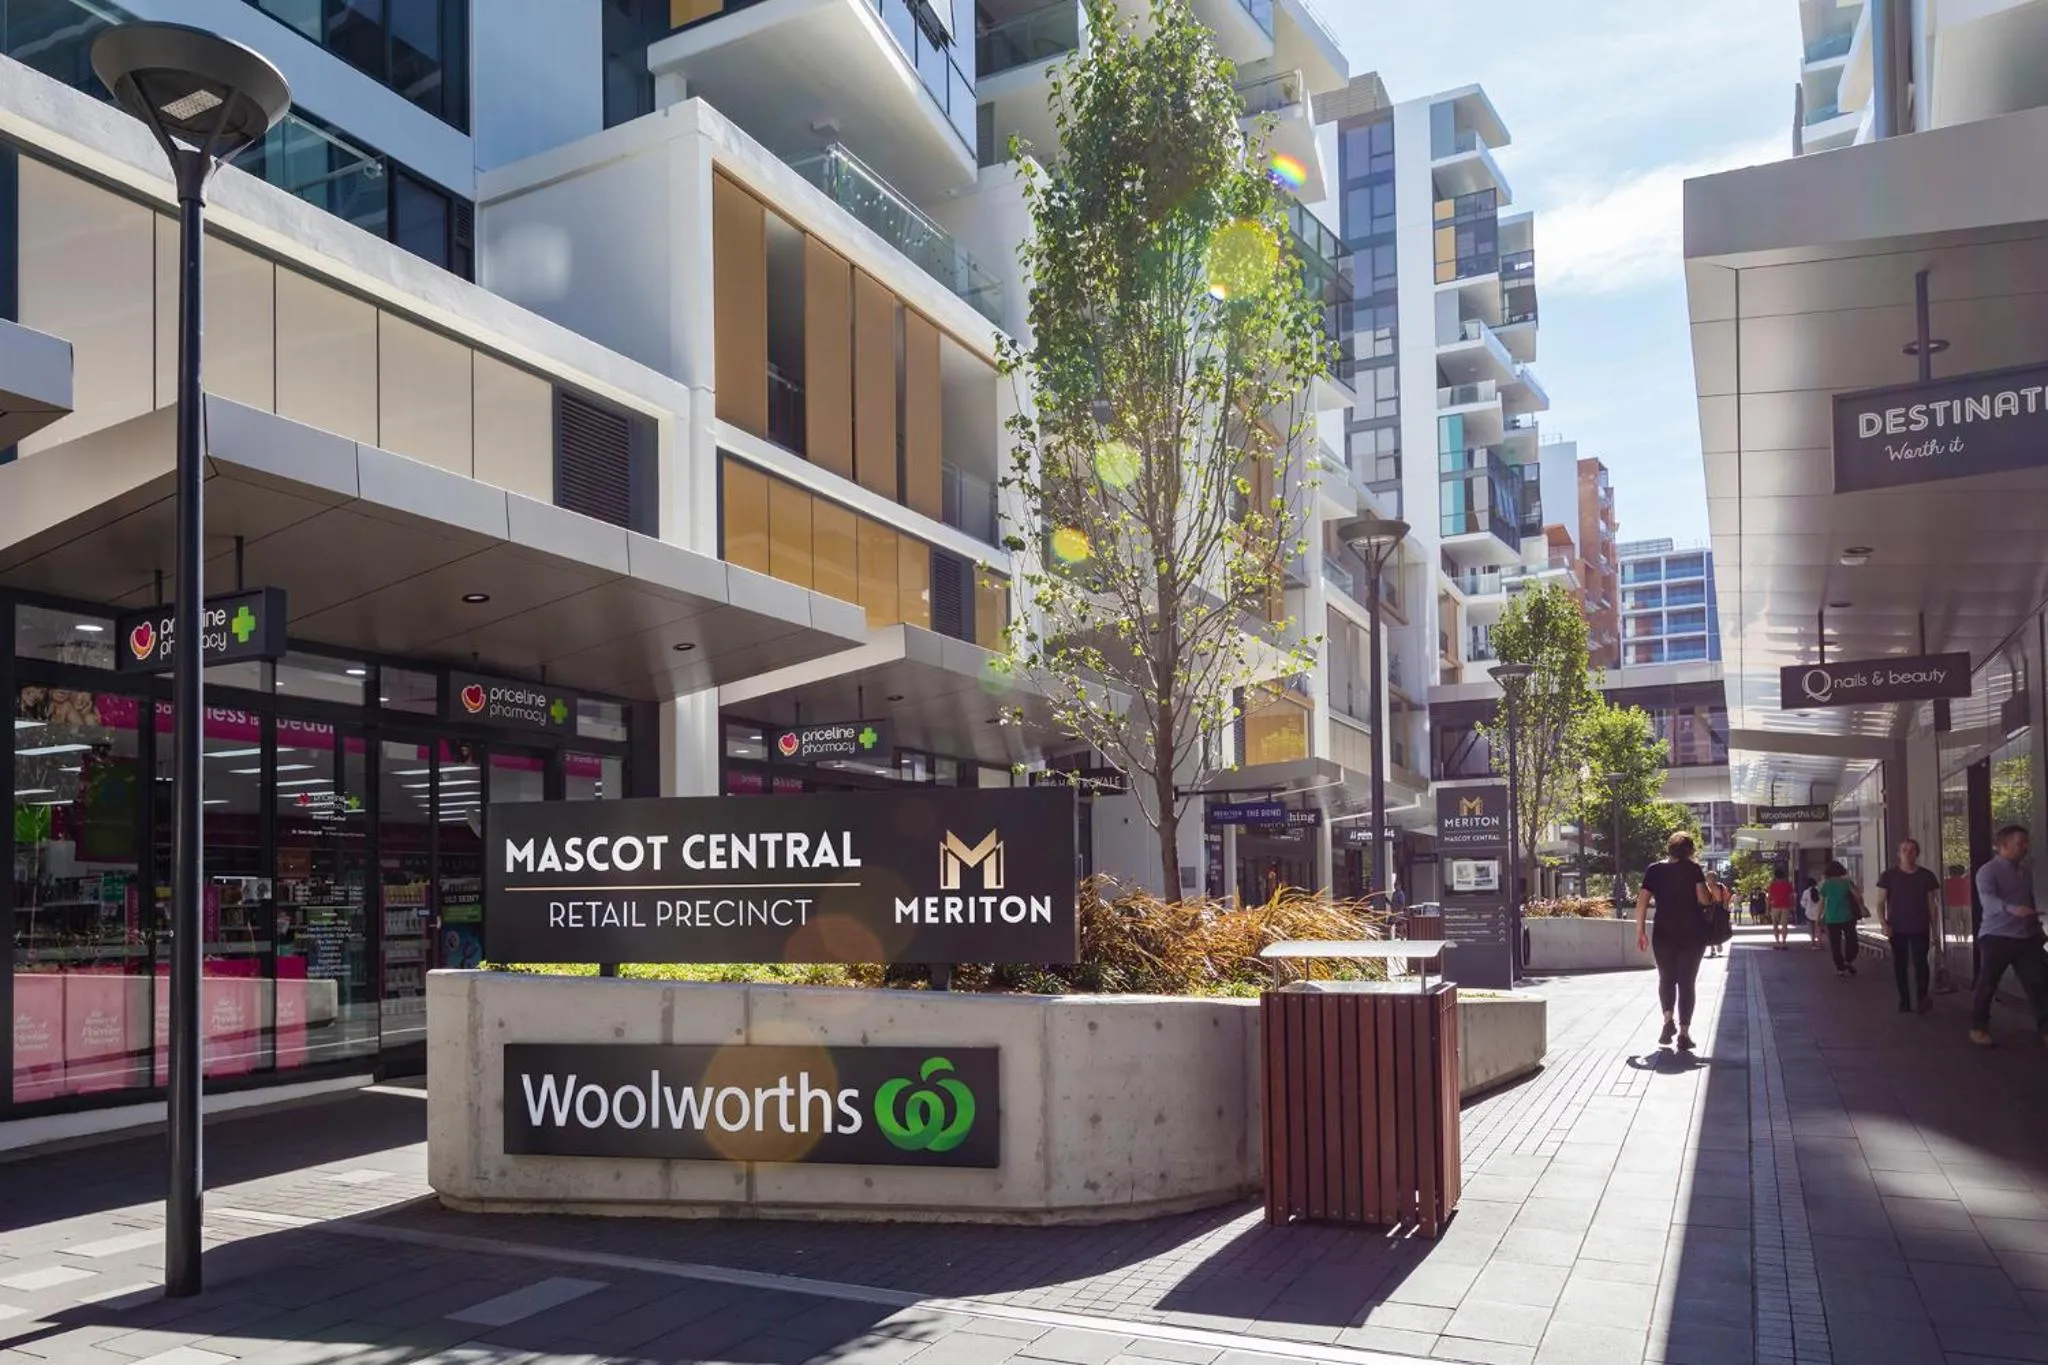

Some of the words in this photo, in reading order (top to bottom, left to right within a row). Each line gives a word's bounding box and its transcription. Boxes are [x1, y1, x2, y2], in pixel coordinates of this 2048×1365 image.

[1885, 439, 1945, 461] Worth
[1949, 436, 1965, 453] it
[490, 687, 546, 708] priceline
[1802, 669, 1832, 702] Q
[1834, 672, 1868, 688] nails
[1872, 671, 1884, 685] &
[1889, 668, 1947, 684] beauty
[490, 703, 547, 726] pharmacy
[802, 725, 855, 744] priceline
[802, 742, 856, 757] pharmacy
[1444, 816, 1500, 828] MERITON
[505, 835, 669, 873] MASCOT
[682, 831, 862, 869] CENTRAL
[549, 901, 646, 928] RETAIL
[656, 900, 813, 927] PRECINCT
[895, 896, 1052, 925] MERITON
[521, 1069, 862, 1135] Woolworths
